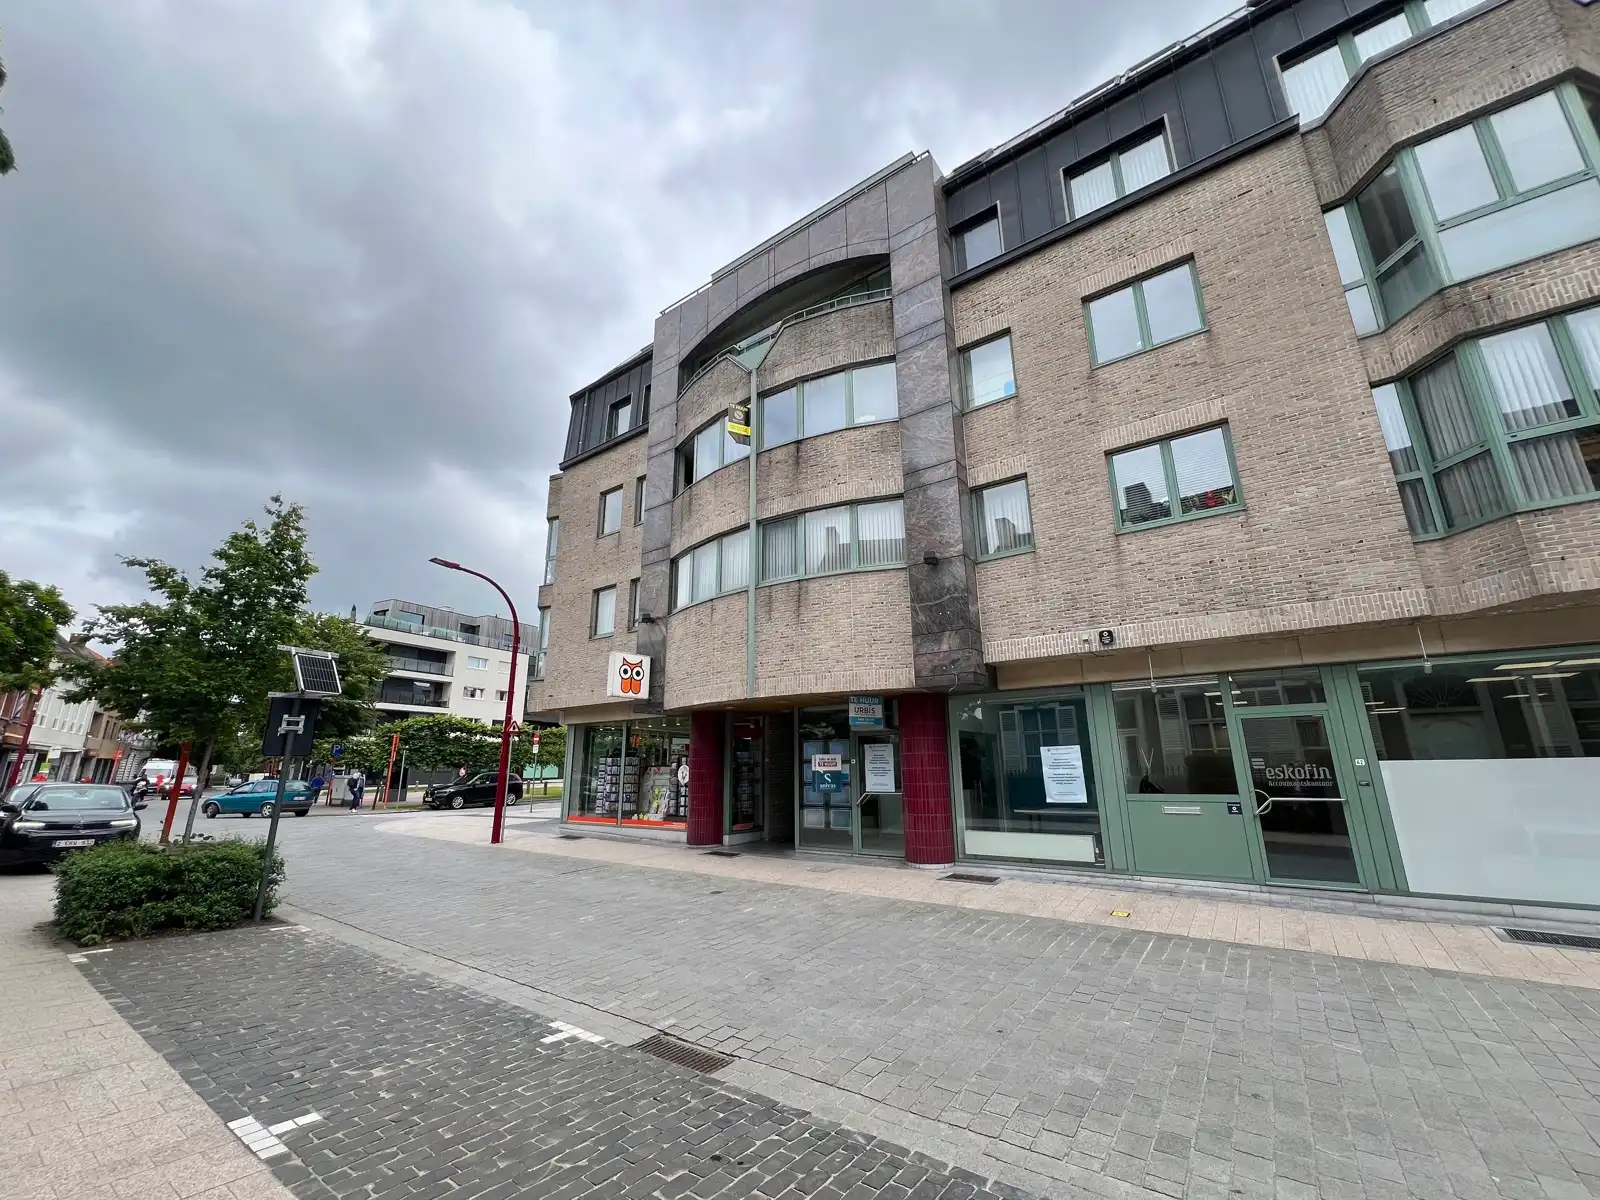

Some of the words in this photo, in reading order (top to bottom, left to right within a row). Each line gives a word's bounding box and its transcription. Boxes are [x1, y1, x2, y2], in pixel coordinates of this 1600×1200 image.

[854, 706, 876, 714] URBIS
[333, 744, 341, 754] P
[1265, 764, 1332, 779] eskofin
